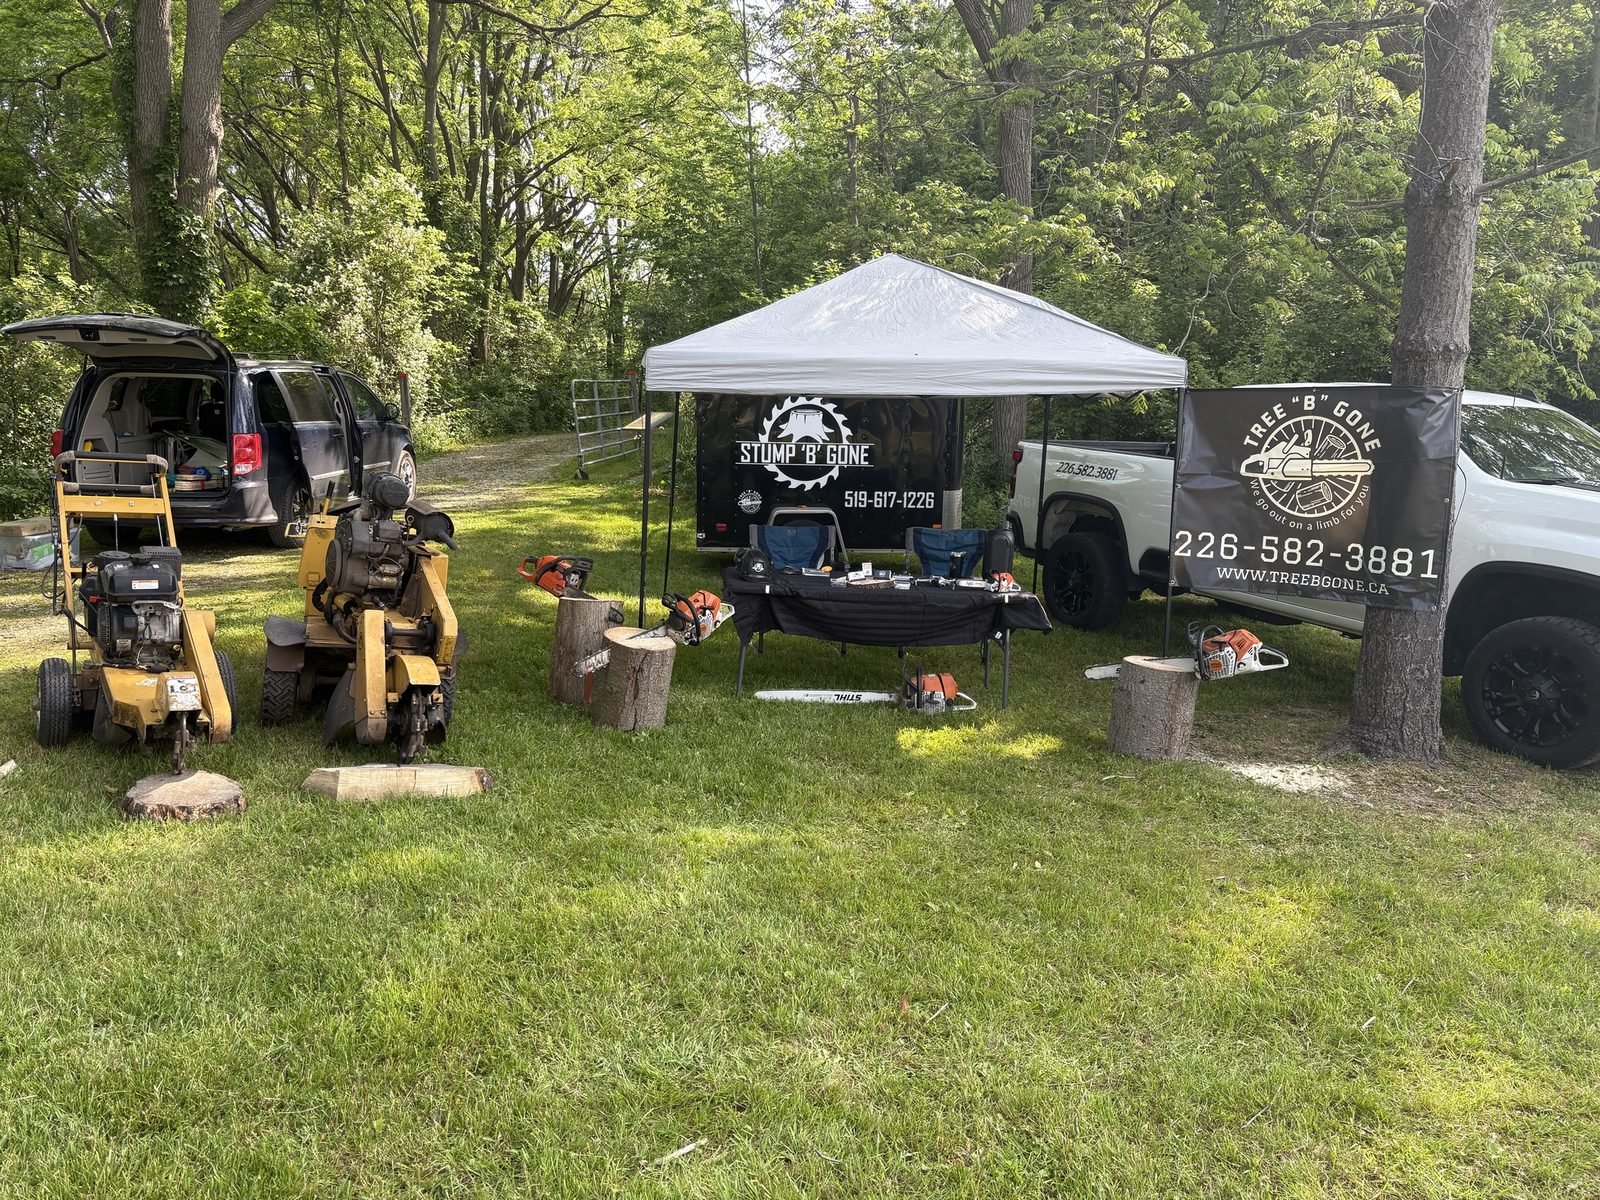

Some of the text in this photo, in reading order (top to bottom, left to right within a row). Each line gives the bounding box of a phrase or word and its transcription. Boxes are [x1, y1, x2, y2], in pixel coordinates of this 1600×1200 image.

[1243, 403, 1287, 447] TREE
[1332, 400, 1382, 452] GONE
[740, 443, 796, 464] STUMP
[826, 445, 870, 465] GONE
[1055, 461, 1119, 481] 226.582.3881
[844, 490, 935, 509] 519-617-1226
[1250, 478, 1370, 531] We go out on a limb for you
[1174, 530, 1439, 579] 226-582-3881
[1216, 566, 1390, 596] WWW.TREEBGONE.CA
